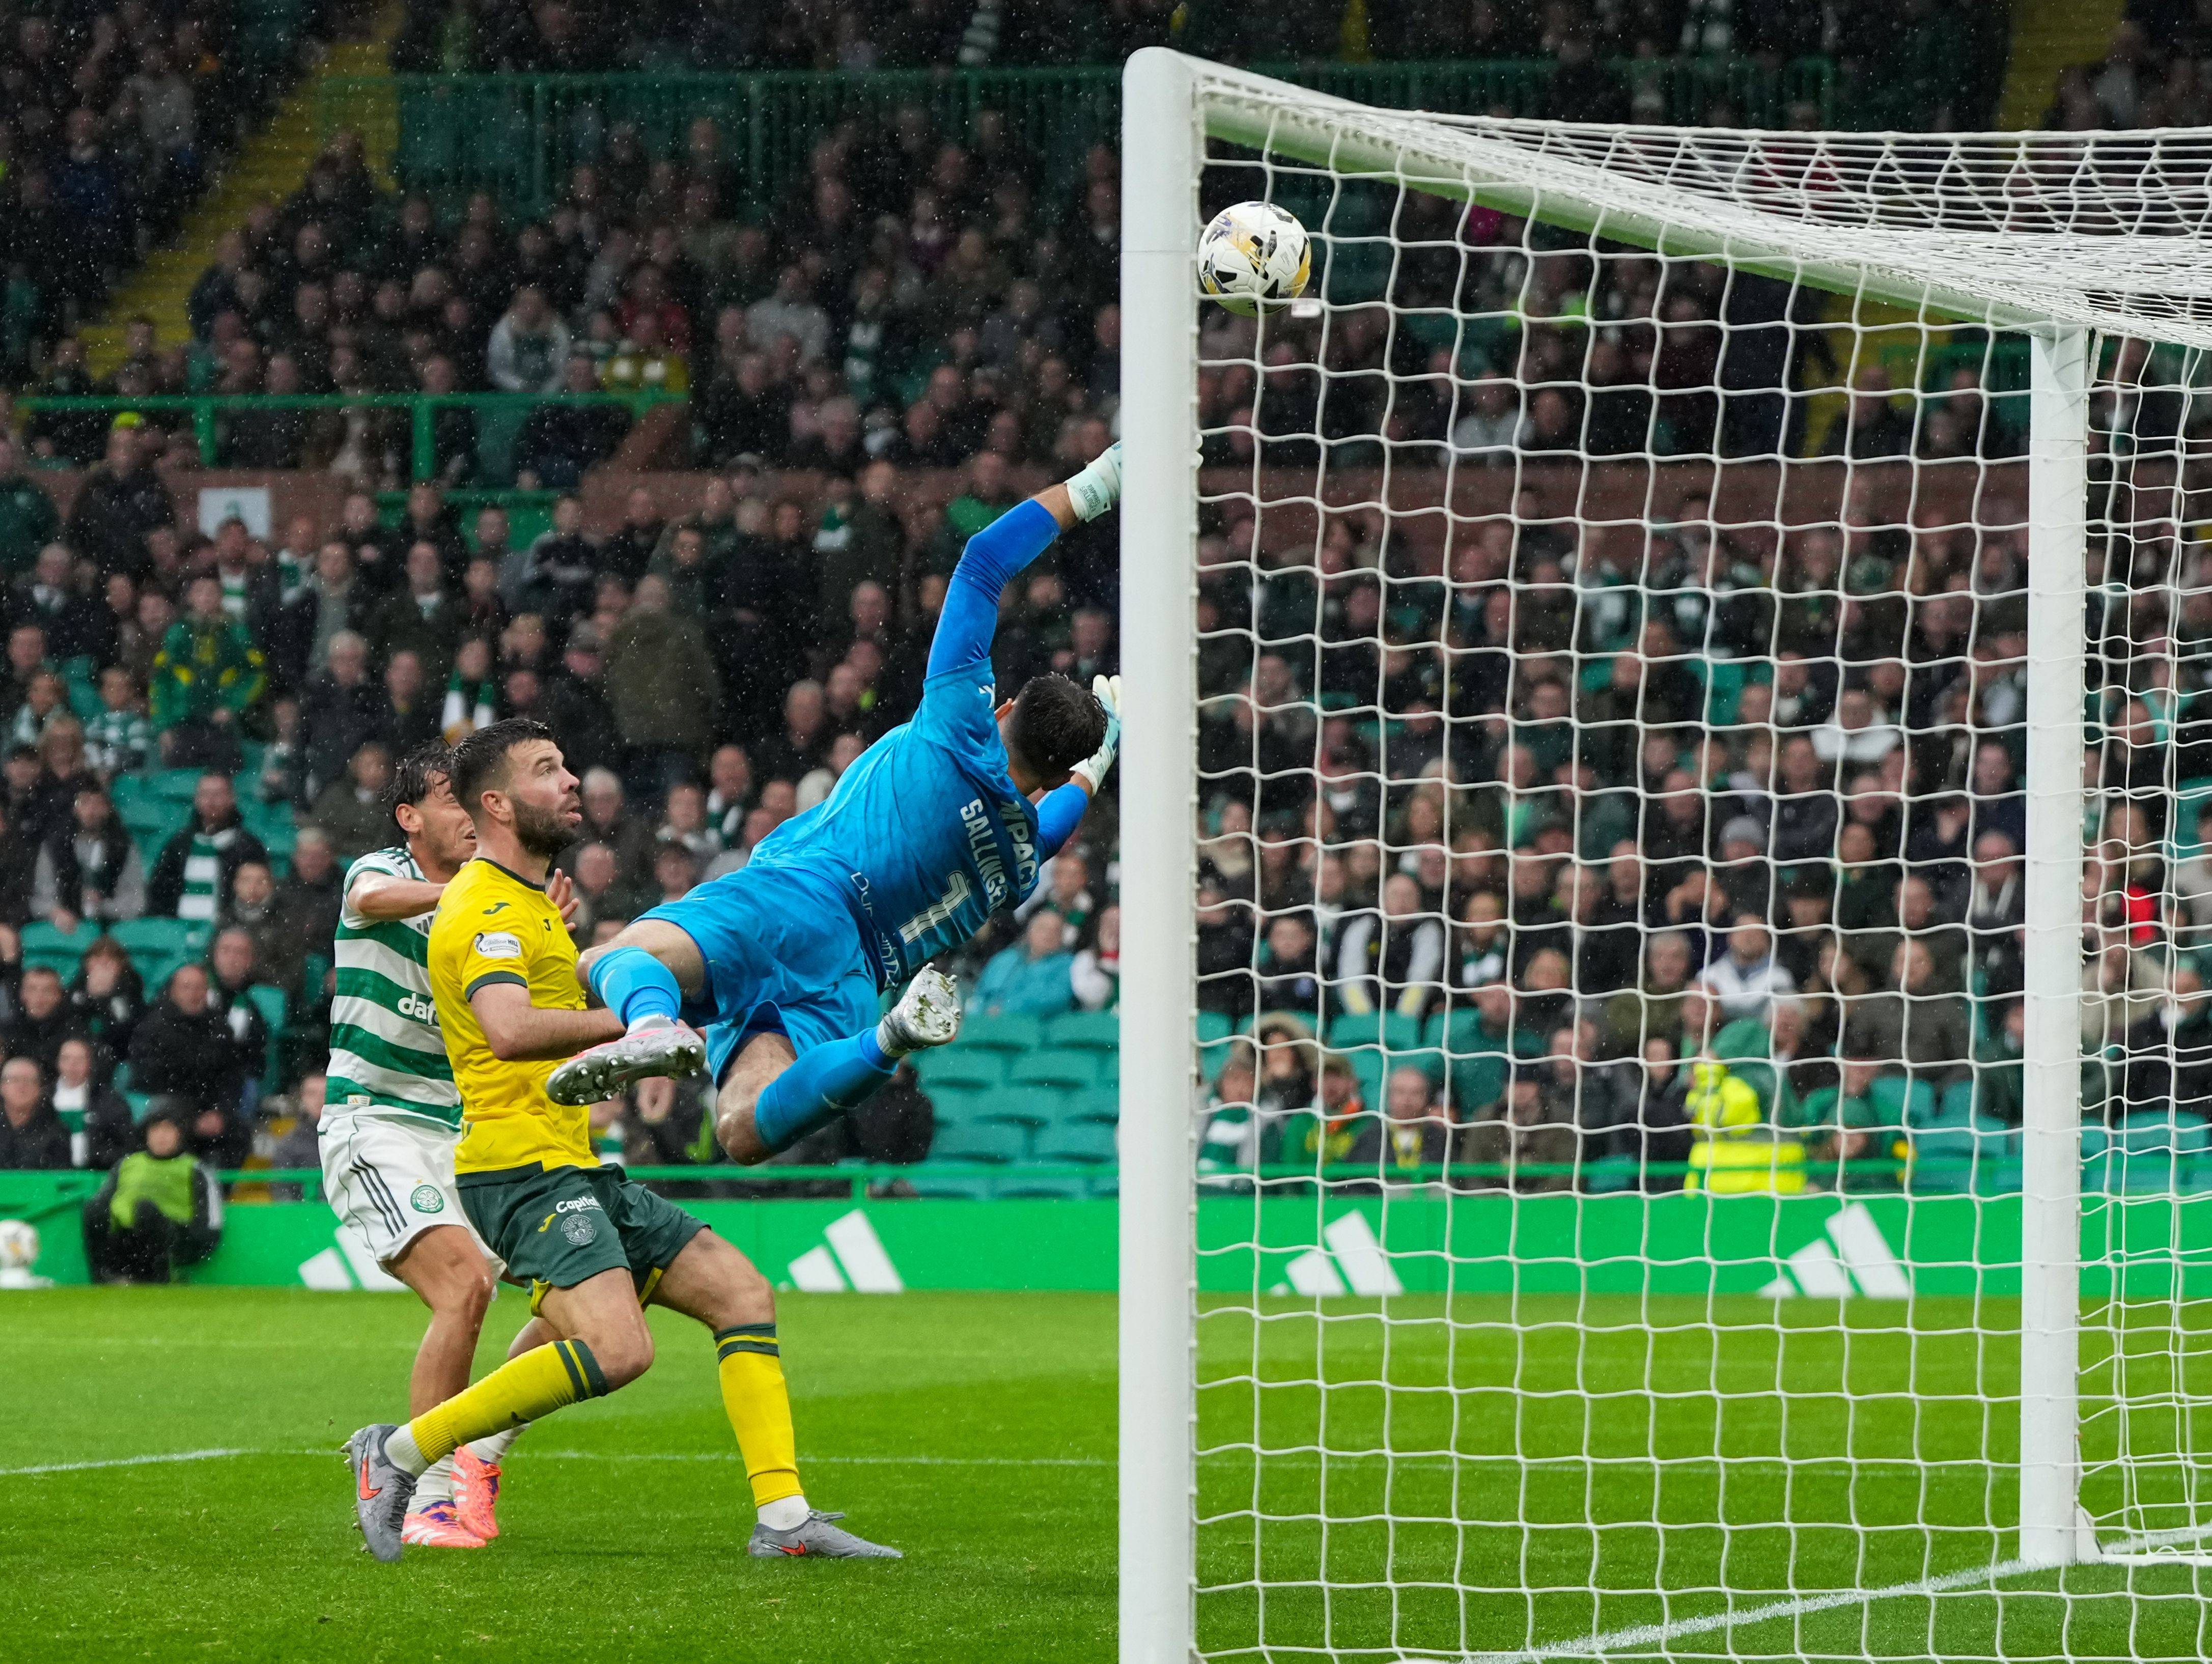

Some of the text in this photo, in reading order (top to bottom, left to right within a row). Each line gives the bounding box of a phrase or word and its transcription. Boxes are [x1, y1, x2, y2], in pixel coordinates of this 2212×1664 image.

[1086, 484, 1101, 506] RAPHAEL
[898, 870, 970, 945] 1
[398, 993, 438, 1025] daf
[555, 1196, 599, 1213] Capital
